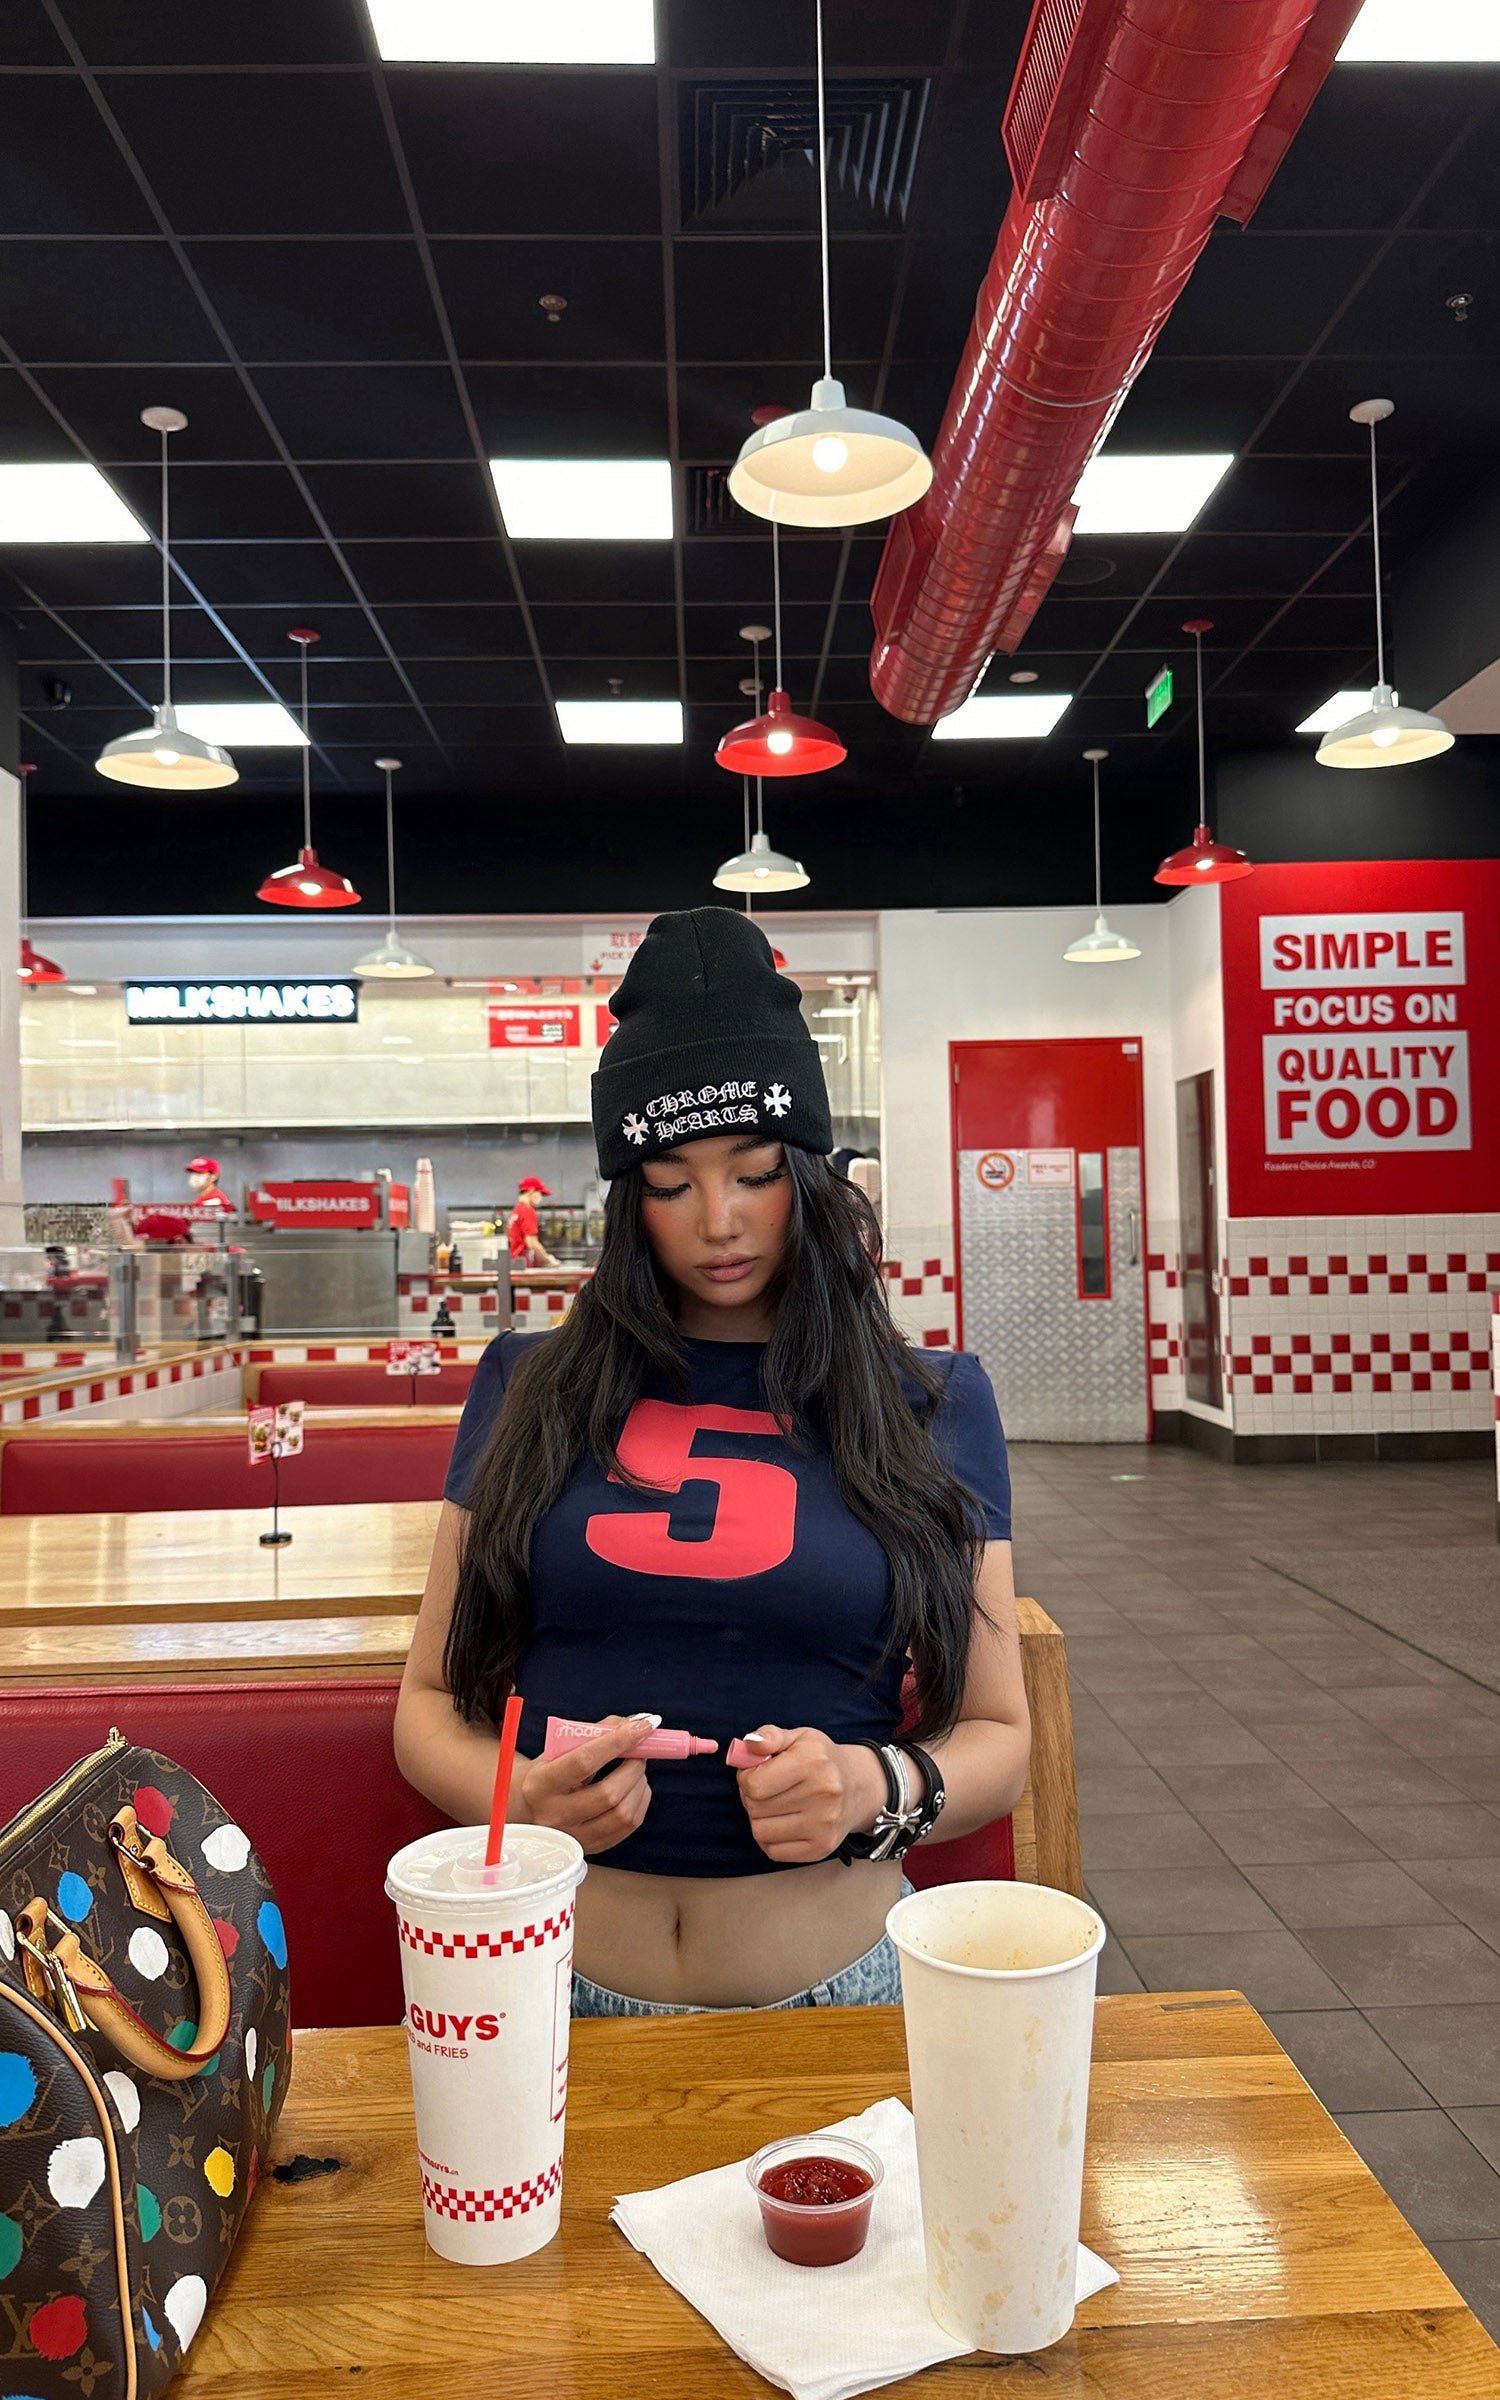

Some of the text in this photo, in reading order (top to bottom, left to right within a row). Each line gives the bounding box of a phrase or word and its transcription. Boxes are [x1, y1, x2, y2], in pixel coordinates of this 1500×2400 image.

[1273, 930, 1453, 972] SIMPLE
[126, 984, 355, 1018] MILKSHAKES
[1273, 993, 1457, 1027] FOCUS ON
[1277, 1046, 1455, 1083] QUALITY
[646, 1080, 759, 1117] CHROME
[1276, 1087, 1458, 1140] FOOD
[653, 1103, 758, 1143] HEARTS
[585, 1398, 798, 1579] 5
[416, 2040, 469, 2059] and FRIES
